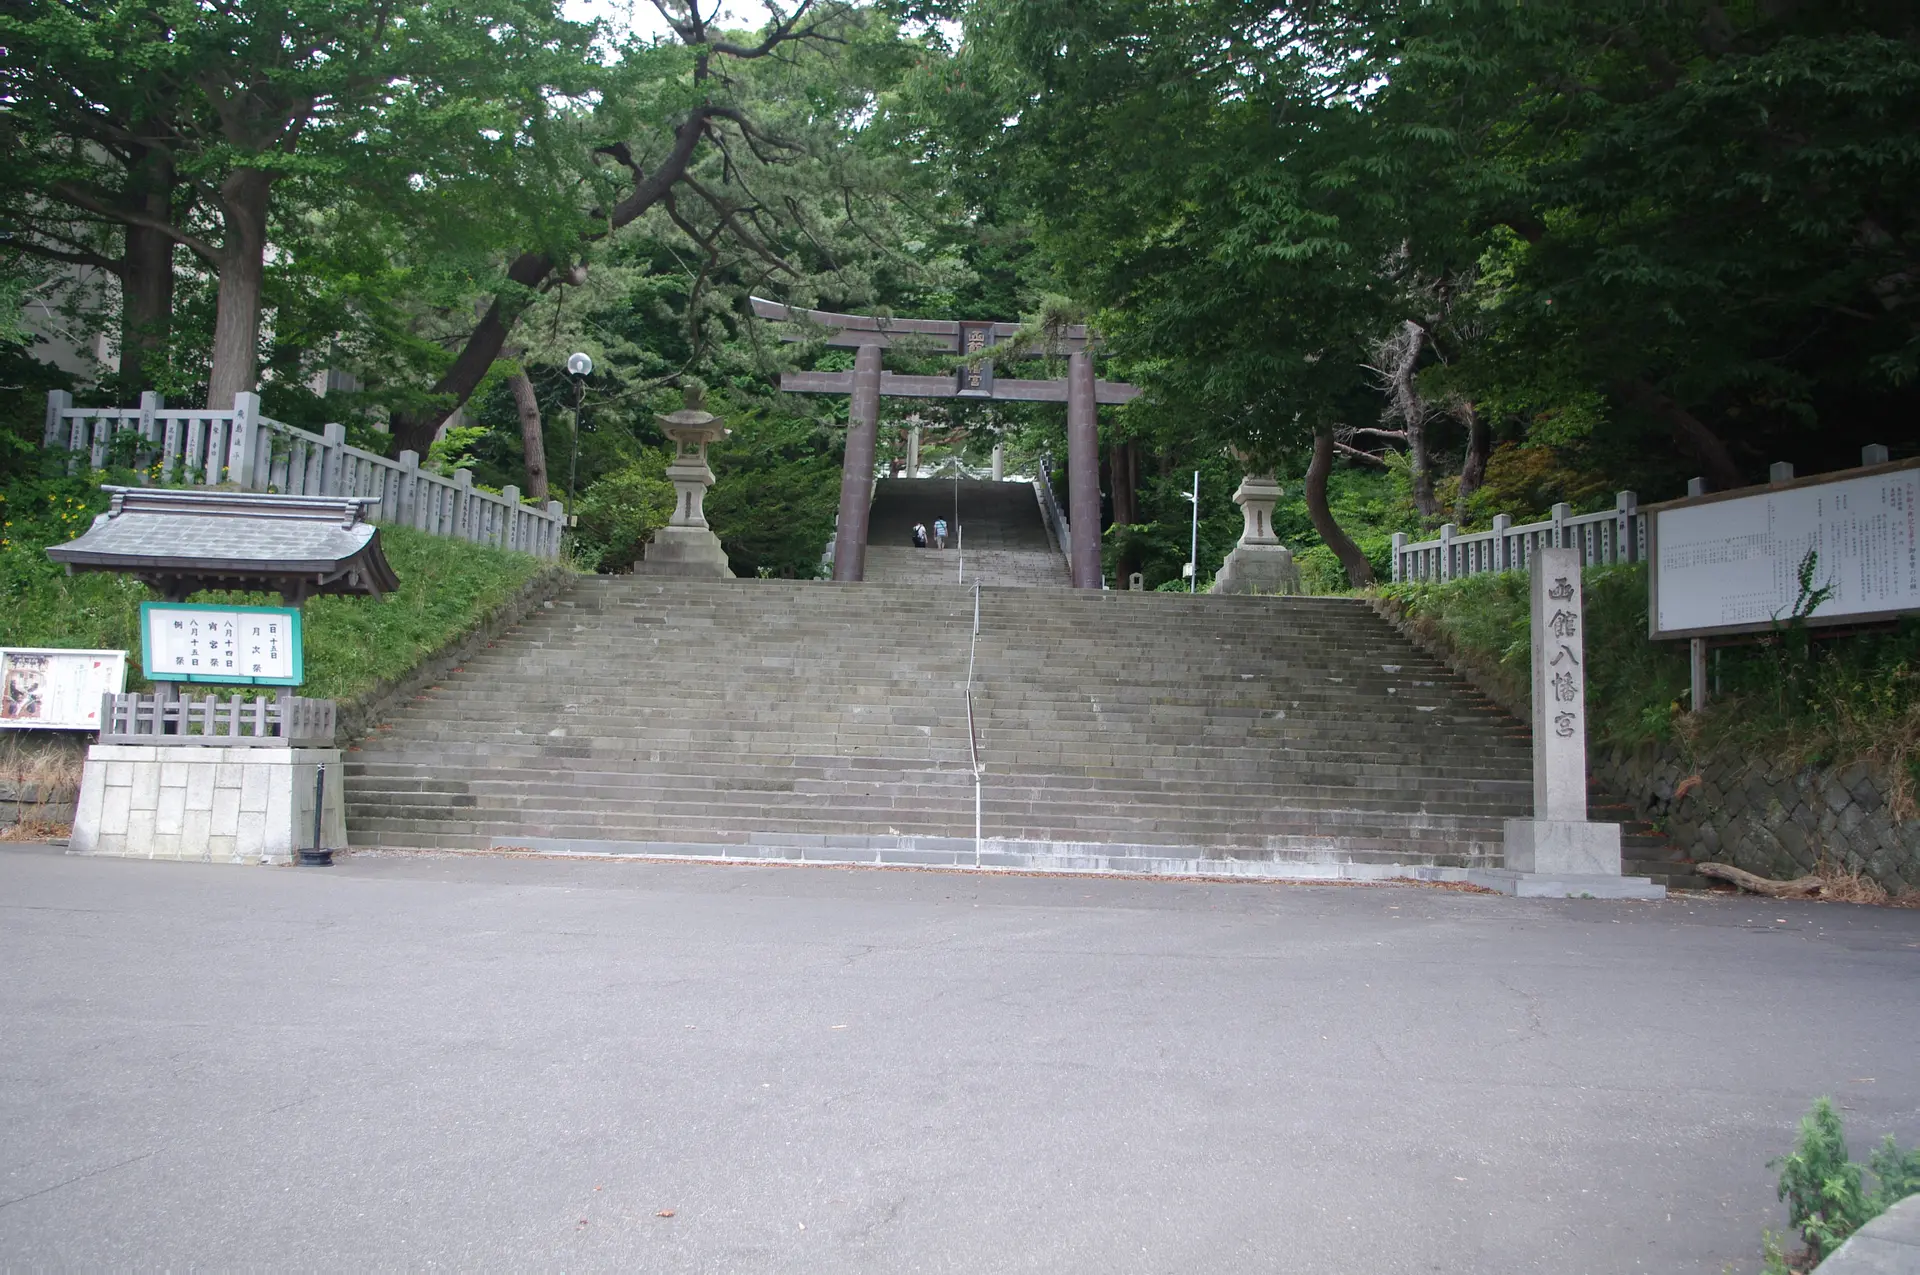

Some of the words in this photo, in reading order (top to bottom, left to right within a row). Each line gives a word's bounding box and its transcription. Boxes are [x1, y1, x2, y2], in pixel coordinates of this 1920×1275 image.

[189, 618, 199, 667] 八月十五日
[208, 621, 219, 668] 宵宮祭
[223, 619, 233, 668] 八月十四日
[252, 626, 262, 673] 月次祭
[1548, 576, 1580, 738] 函館八幡宮
